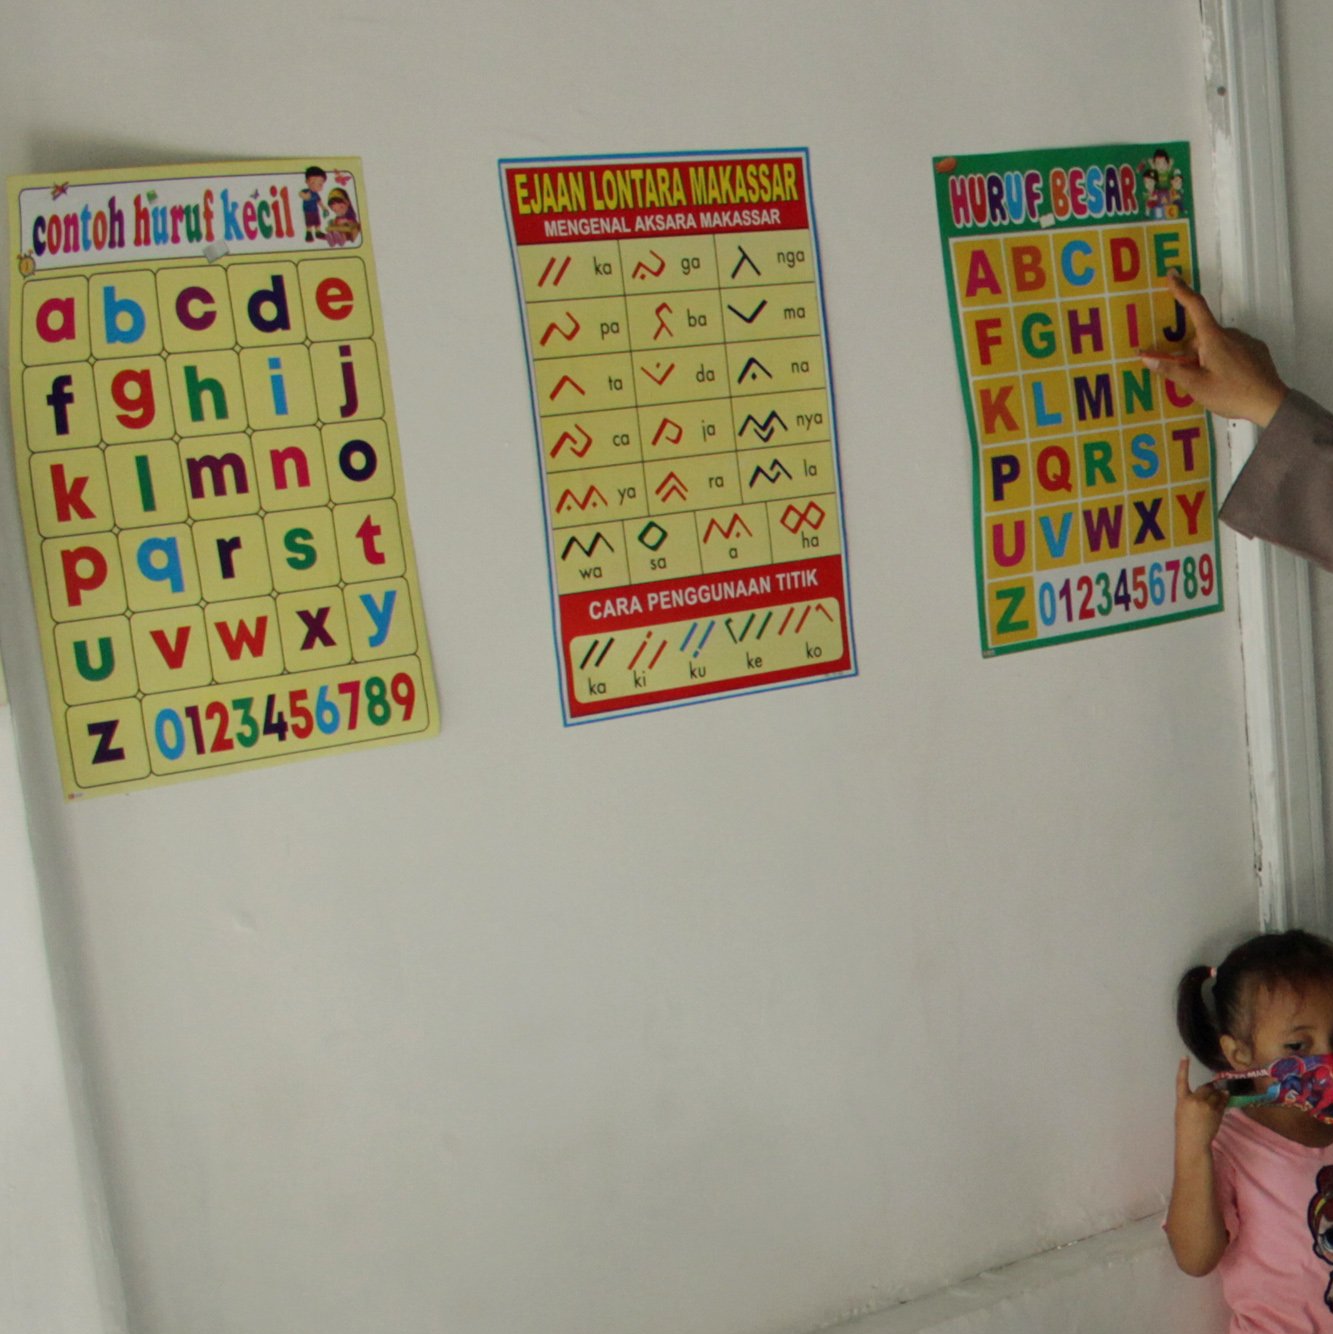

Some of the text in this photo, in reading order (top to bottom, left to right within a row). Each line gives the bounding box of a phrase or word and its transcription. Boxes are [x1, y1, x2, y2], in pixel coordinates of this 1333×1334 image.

[514, 162, 799, 215] EJAAN LONTARA MAKASSAR
[950, 164, 1138, 226] HURUF BESAR
[33, 186, 294, 256] contoh huruf kecil
[544, 209, 781, 237] MENGENAL AKSARA MAKASSAR
[593, 256, 612, 276] ka
[681, 257, 700, 275] ga
[777, 250, 805, 268] nga
[965, 232, 1182, 298] A B C D E
[36, 274, 354, 343] a b c d e
[688, 309, 707, 328] ba
[784, 305, 806, 320] ma
[600, 320, 620, 339] pa
[974, 299, 1186, 365] F G H I J
[696, 364, 715, 383] da
[791, 360, 809, 373] na
[47, 345, 359, 435] f g h i j
[609, 375, 623, 391] ta
[979, 385, 1020, 434] K
[1032, 382, 1063, 427] L
[1073, 374, 1114, 421] M
[1122, 368, 1154, 414] N
[702, 419, 715, 442] ja
[796, 412, 823, 432] nya
[613, 432, 630, 446] ca
[804, 460, 817, 476] la
[991, 428, 1200, 502] P Q R S T
[50, 439, 377, 522] k l m n o
[708, 475, 724, 488] ra
[618, 485, 636, 505] ya
[802, 531, 819, 548] ha
[992, 491, 1205, 568] U V W X Y
[60, 514, 386, 607] p q r s t
[650, 555, 667, 569] sa
[729, 547, 738, 559] a
[579, 565, 602, 579] wa
[589, 568, 818, 621] CARA PENGGUNAAN TITIK
[996, 553, 1213, 634] Z 0123456789
[73, 590, 397, 681] u v w x y
[588, 642, 822, 695] ka ki ku ke ko
[87, 671, 416, 765] z 0123456789
